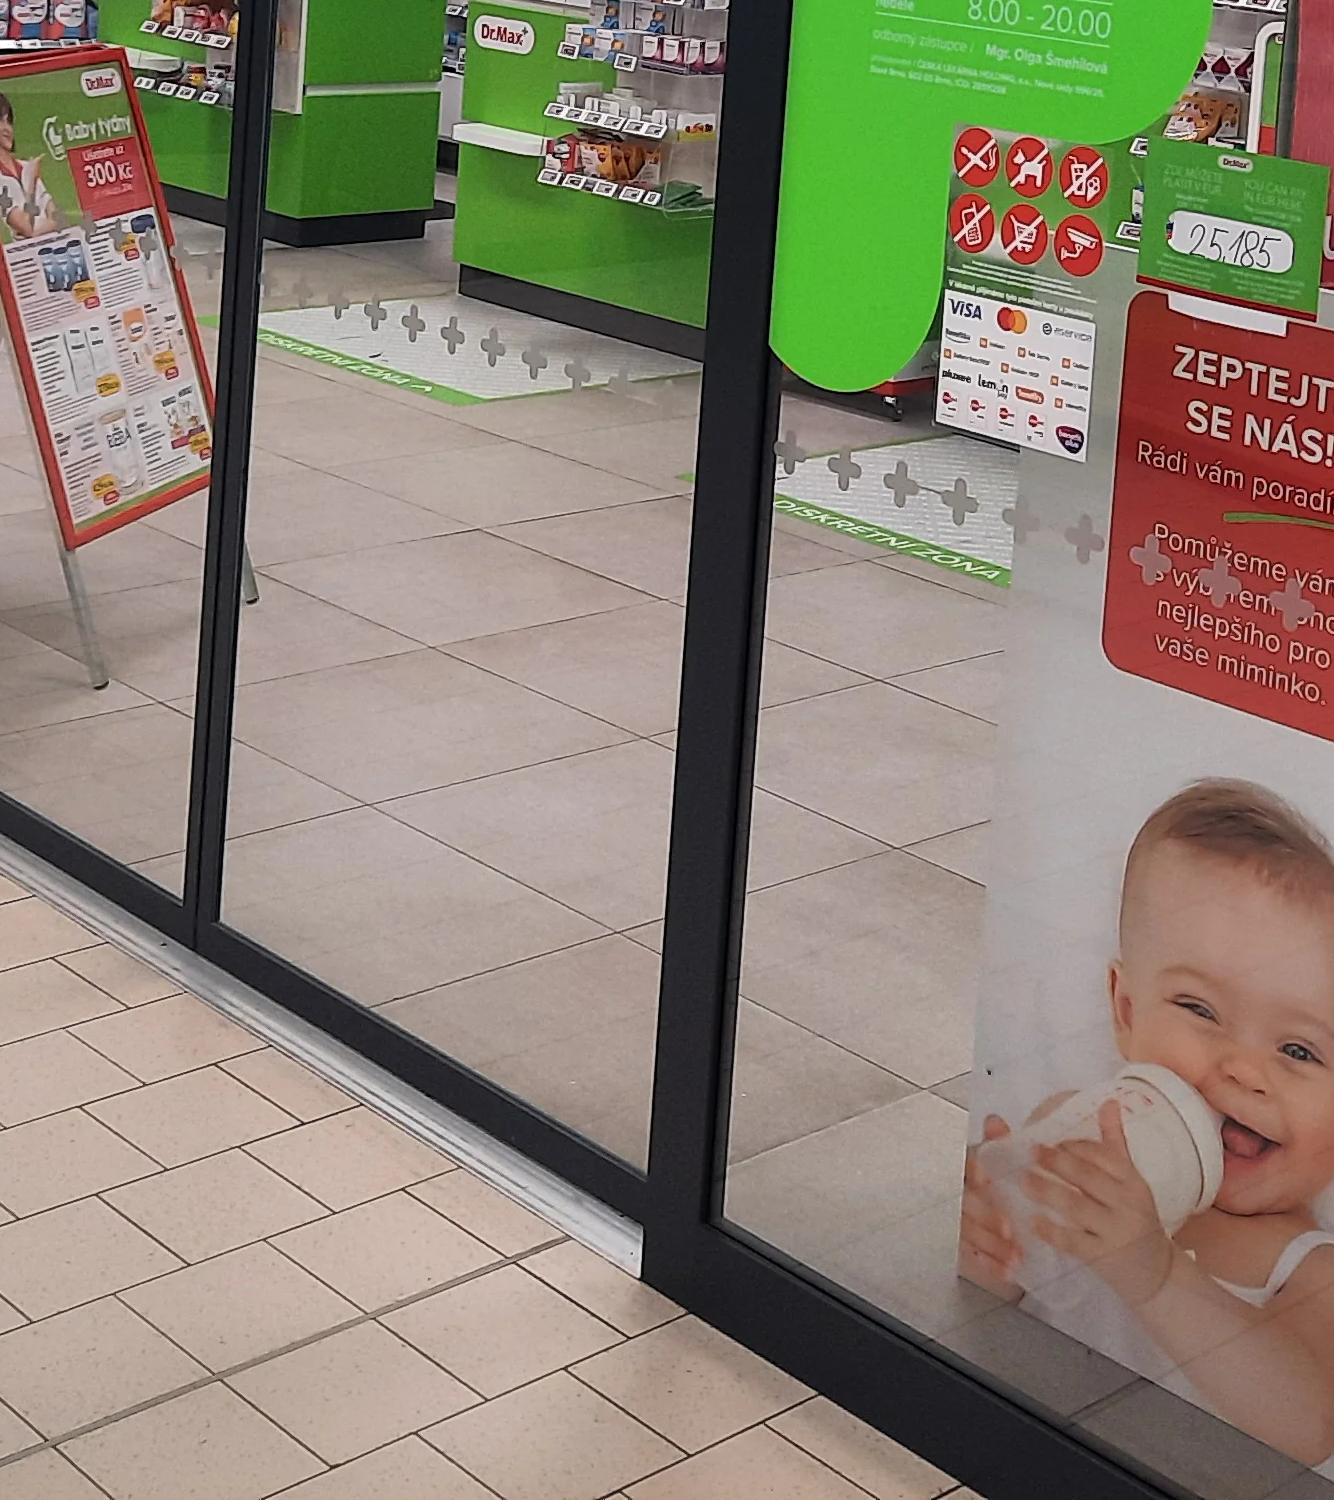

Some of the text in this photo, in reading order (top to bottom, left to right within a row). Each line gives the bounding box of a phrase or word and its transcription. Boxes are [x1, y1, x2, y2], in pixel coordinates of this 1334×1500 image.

[481, 23, 525, 46] Dr.Max
[1040, 4, 1112, 39] 20.00
[919, 35, 967, 53] zástupce
[986, 43, 1011, 61] Mgr.
[1014, 48, 1042, 67] Olga
[1045, 49, 1108, 75] Šmehilová
[65, 120, 97, 141] Baby
[83, 160, 134, 188] 300 Kč
[948, 298, 982, 320] VISA
[260, 333, 410, 390] DISKRETNÍ ZÓNA
[1186, 400, 1233, 442] SE
[1137, 441, 1188, 476] Rádi
[1195, 458, 1245, 490] vám
[775, 498, 1001, 581] DISKRETNÍ ZÓNA
[1154, 523, 1287, 582] Pomůžeme
[1157, 599, 1331, 670] nejlepšího pro
[1155, 633, 1327, 706] vaše miminko.
